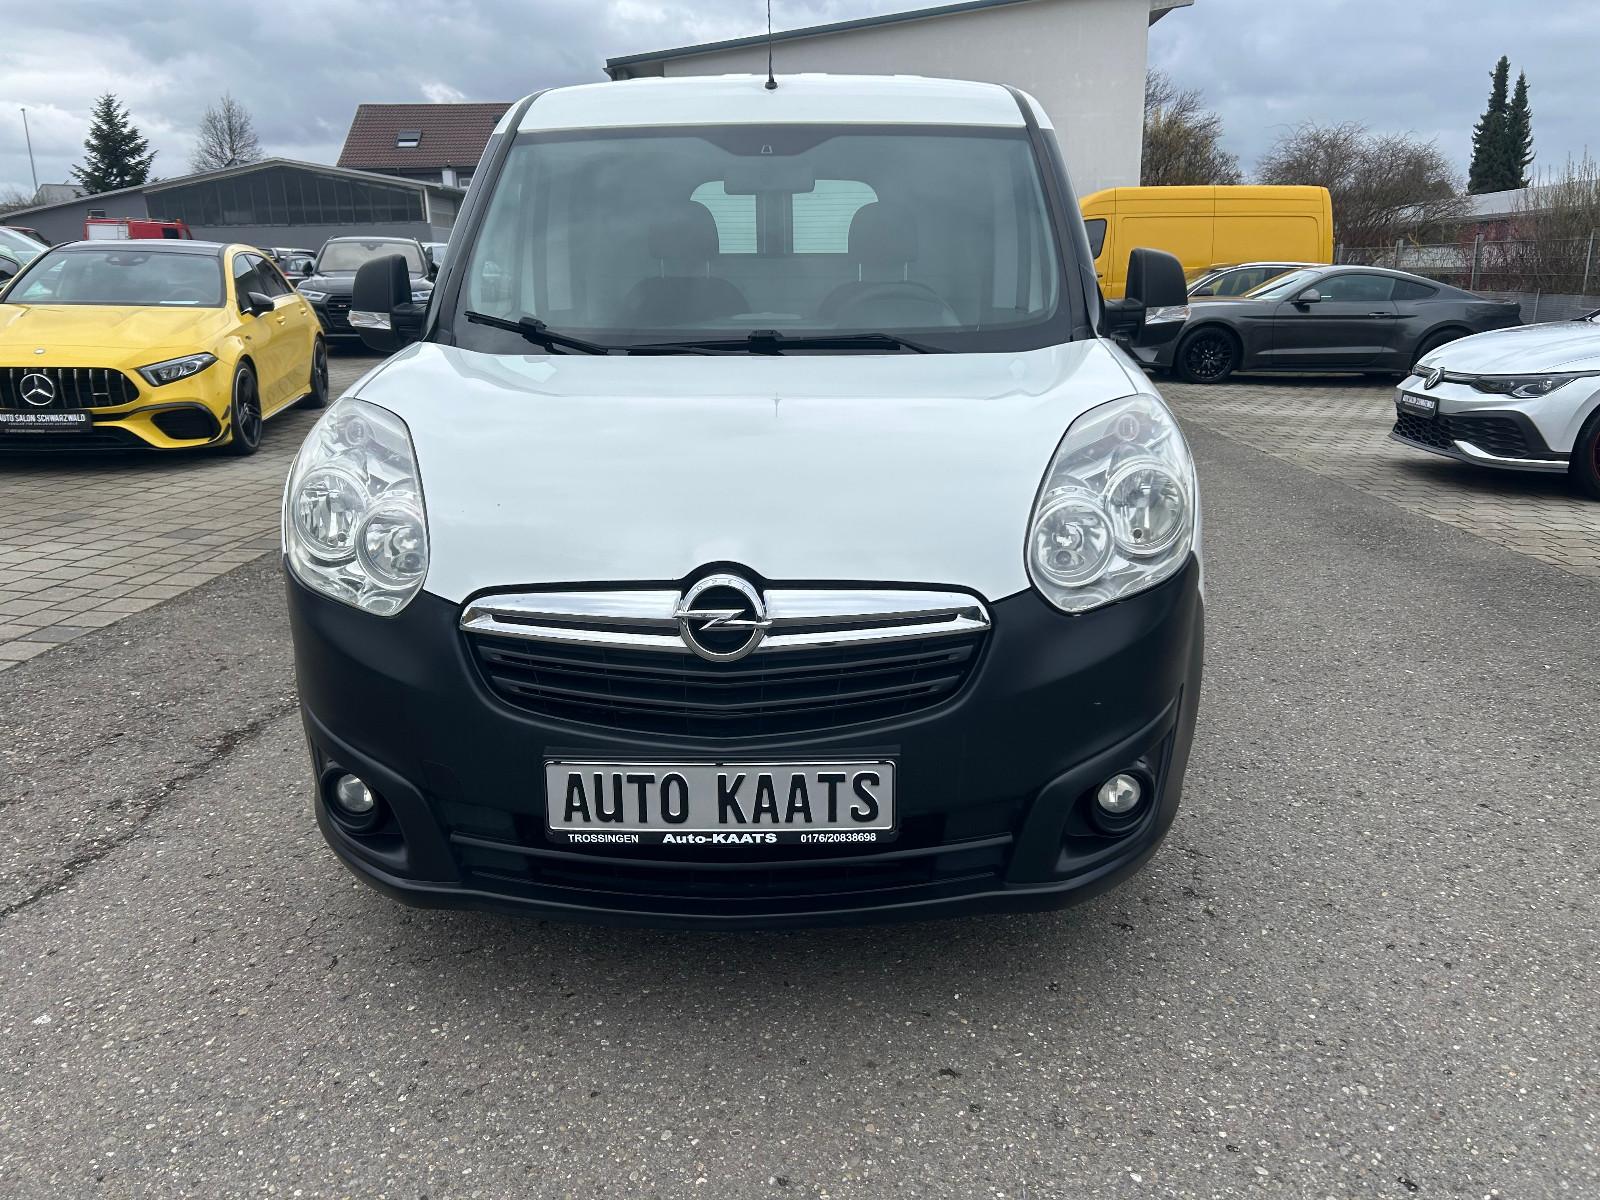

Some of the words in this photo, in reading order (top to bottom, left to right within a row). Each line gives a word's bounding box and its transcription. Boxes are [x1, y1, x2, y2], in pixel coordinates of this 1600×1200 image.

[14, 414, 36, 422] SALON
[36, 413, 86, 422] SCHWARZWALD
[563, 771, 690, 823] AUTO
[716, 770, 880, 824] KAATS
[567, 833, 639, 843] TROSSINGEN
[662, 833, 777, 844] Auto-KAATS
[800, 832, 877, 843] 0176/20838698
